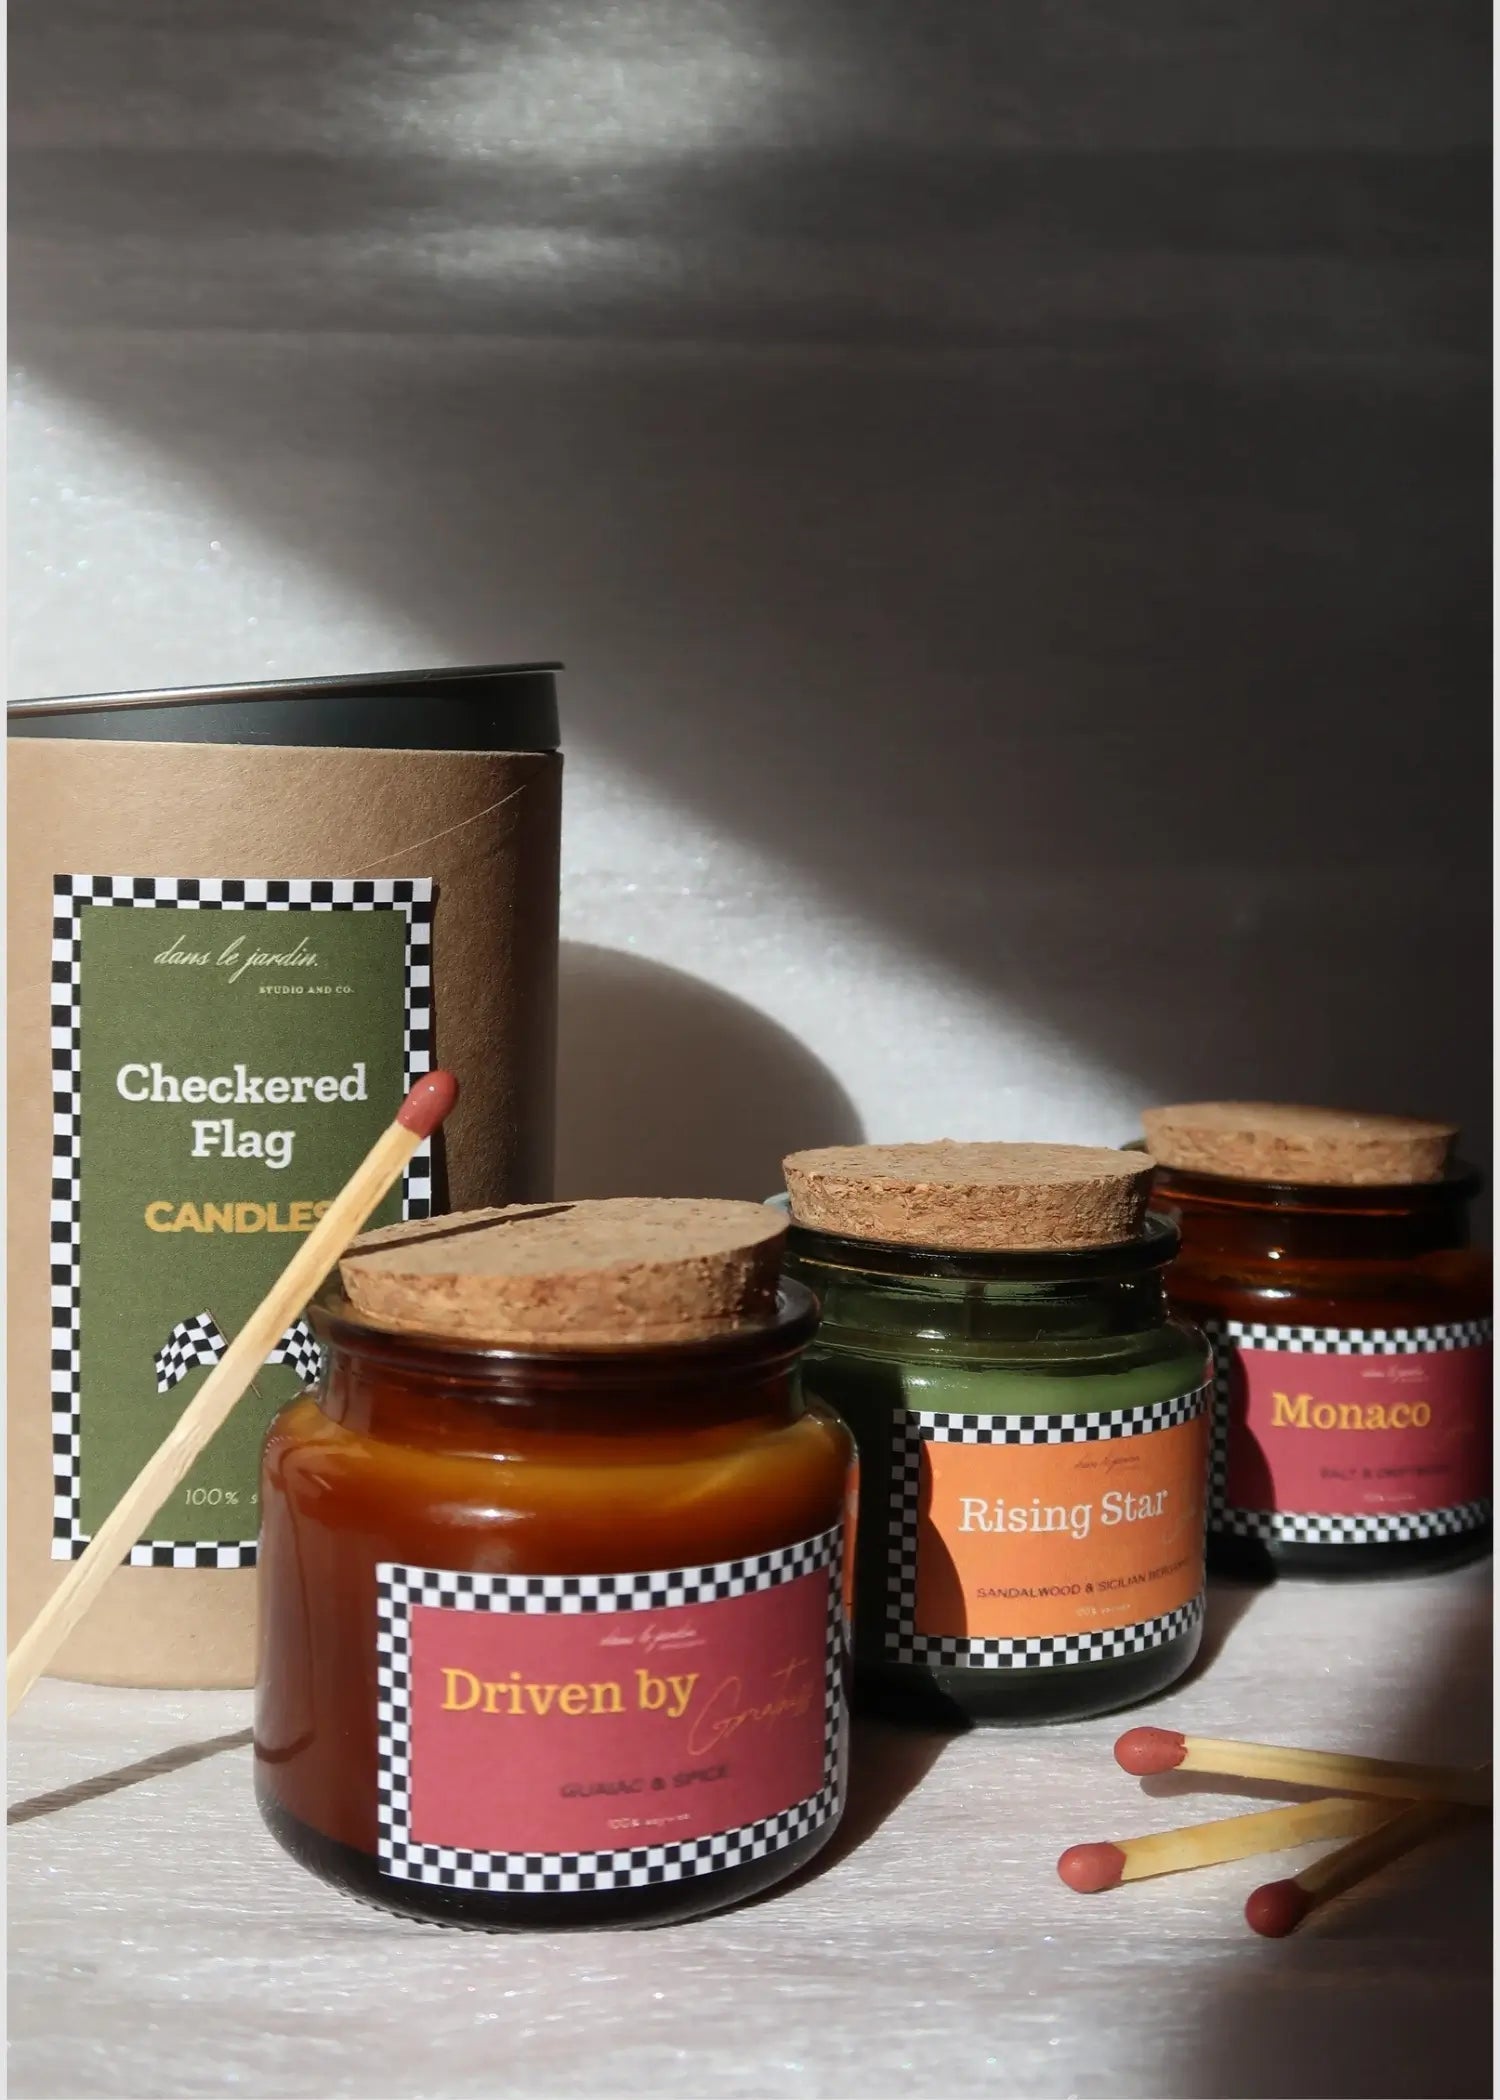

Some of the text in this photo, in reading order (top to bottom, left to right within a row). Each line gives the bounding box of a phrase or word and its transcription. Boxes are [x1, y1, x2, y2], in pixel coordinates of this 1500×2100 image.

[154, 934, 211, 966] dans
[216, 935, 247, 966] le
[259, 985, 304, 994] STUDIO
[308, 985, 332, 994] AND
[116, 1063, 368, 1103] Checkered
[191, 1119, 295, 1169] Flag
[1271, 1392, 1431, 1430] Monaco
[185, 1488, 240, 1505] 100%
[958, 1497, 1093, 1539] Rising
[1101, 1489, 1169, 1526] Star
[976, 1582, 1081, 1599] SANDALWOOD
[1085, 1583, 1094, 1594] &
[1098, 1573, 1146, 1592] SICILIAN
[441, 1668, 626, 1716] Driven
[635, 1668, 700, 1718] by
